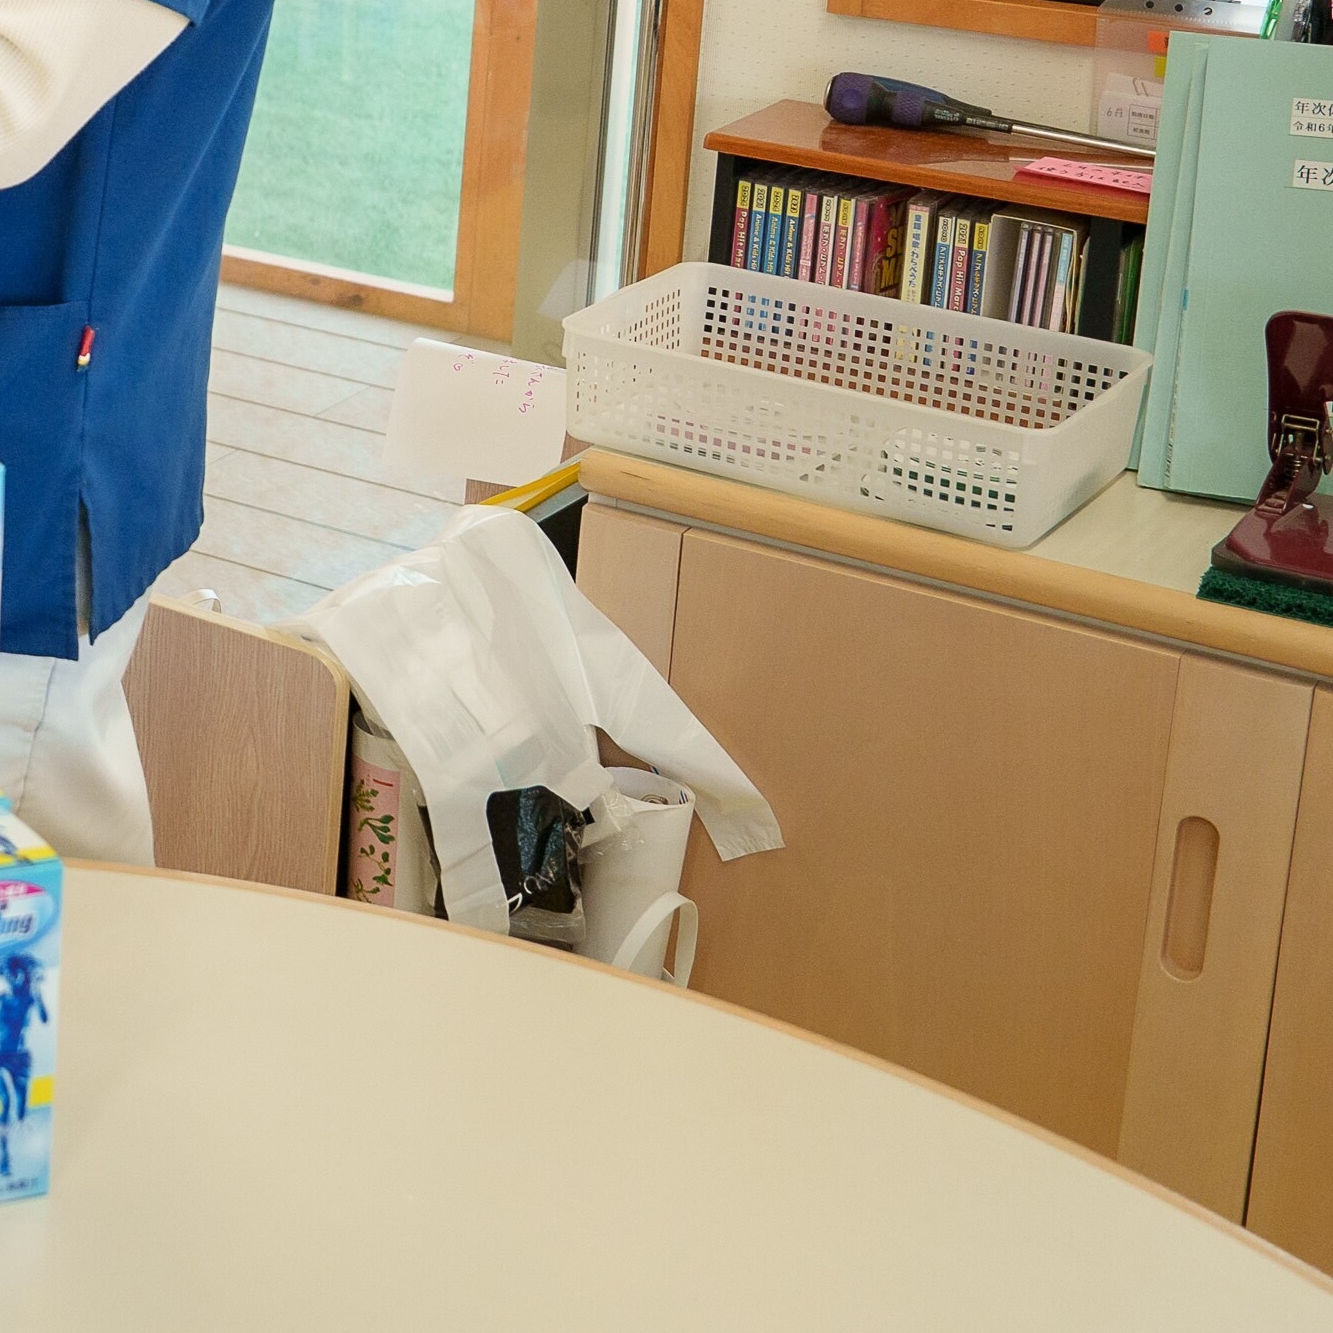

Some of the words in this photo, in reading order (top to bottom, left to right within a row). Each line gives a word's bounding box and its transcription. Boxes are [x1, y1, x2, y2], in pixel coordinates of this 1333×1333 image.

[1105, 106, 1123, 118] 6月
[737, 211, 747, 228] Pop
[754, 213, 763, 235] Anime
[770, 216, 778, 239] Anime
[787, 218, 796, 240] Anime
[737, 232, 746, 246] Hit
[958, 222, 967, 244] 2021
[766, 261, 774, 272] Hit
[955, 249, 966, 268] Pop
